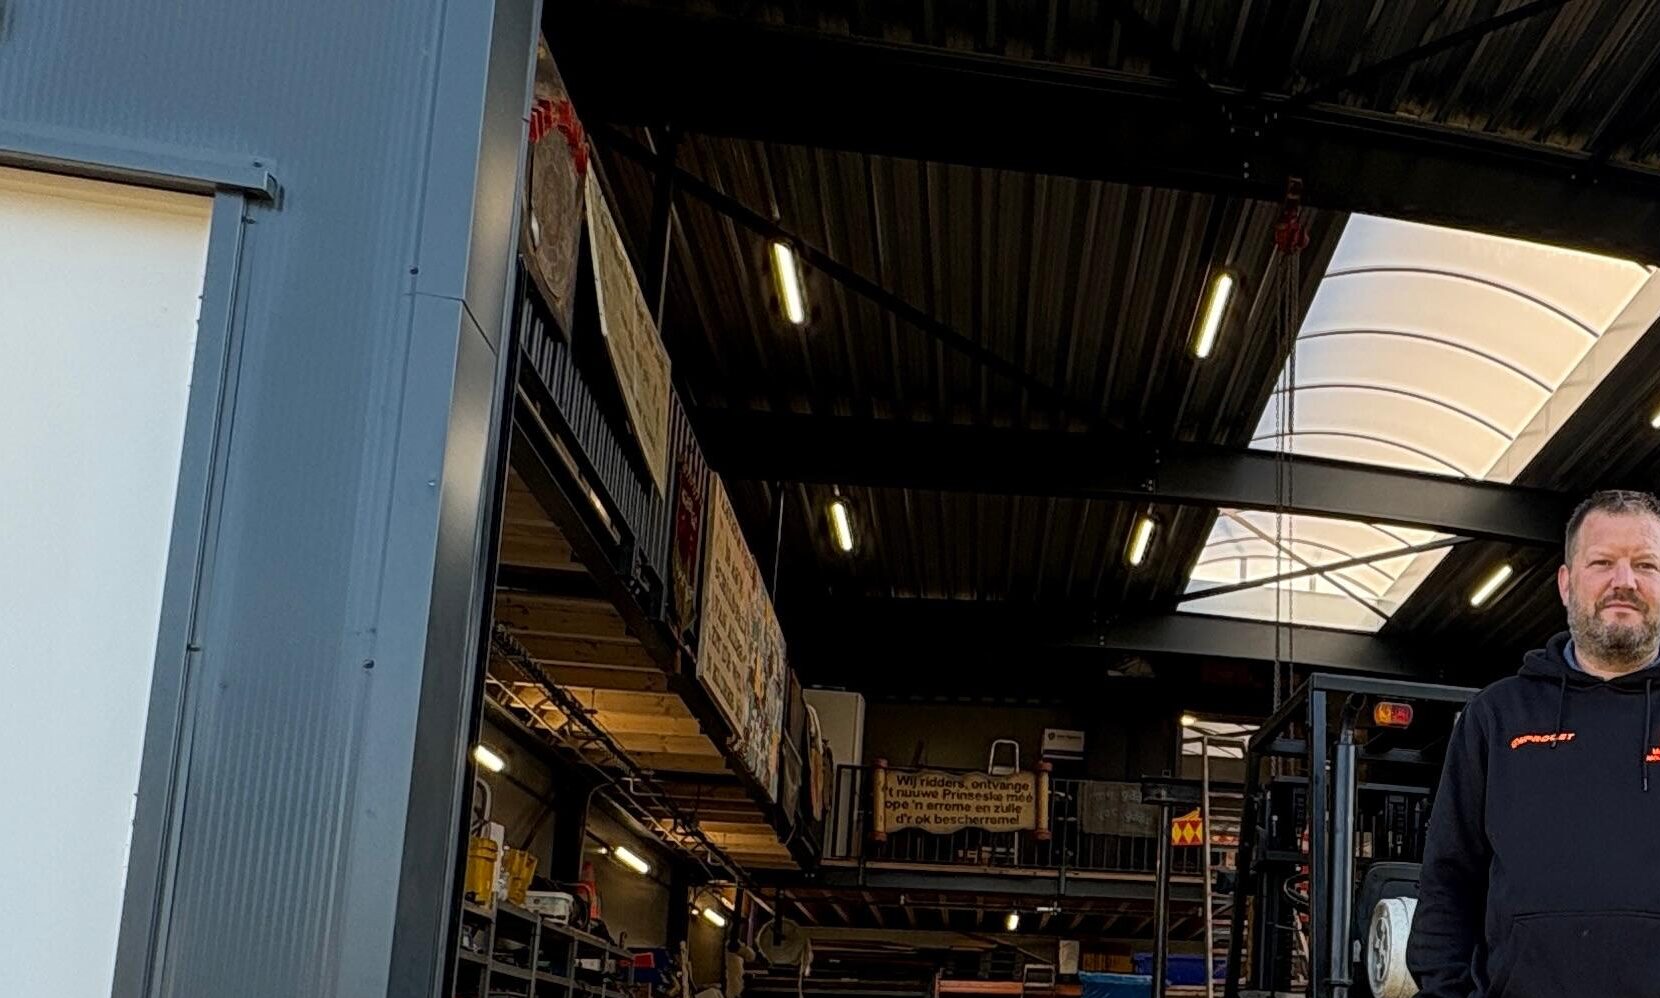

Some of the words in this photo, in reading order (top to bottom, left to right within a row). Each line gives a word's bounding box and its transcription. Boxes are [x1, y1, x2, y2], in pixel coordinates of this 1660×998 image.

[896, 775, 917, 789] Wij
[920, 776, 969, 790] ridders,
[971, 779, 1030, 793] ontvange
[942, 788, 1003, 802] Prinseske
[975, 803, 991, 813] en
[994, 802, 1023, 815] zulle
[915, 813, 931, 825] ok
